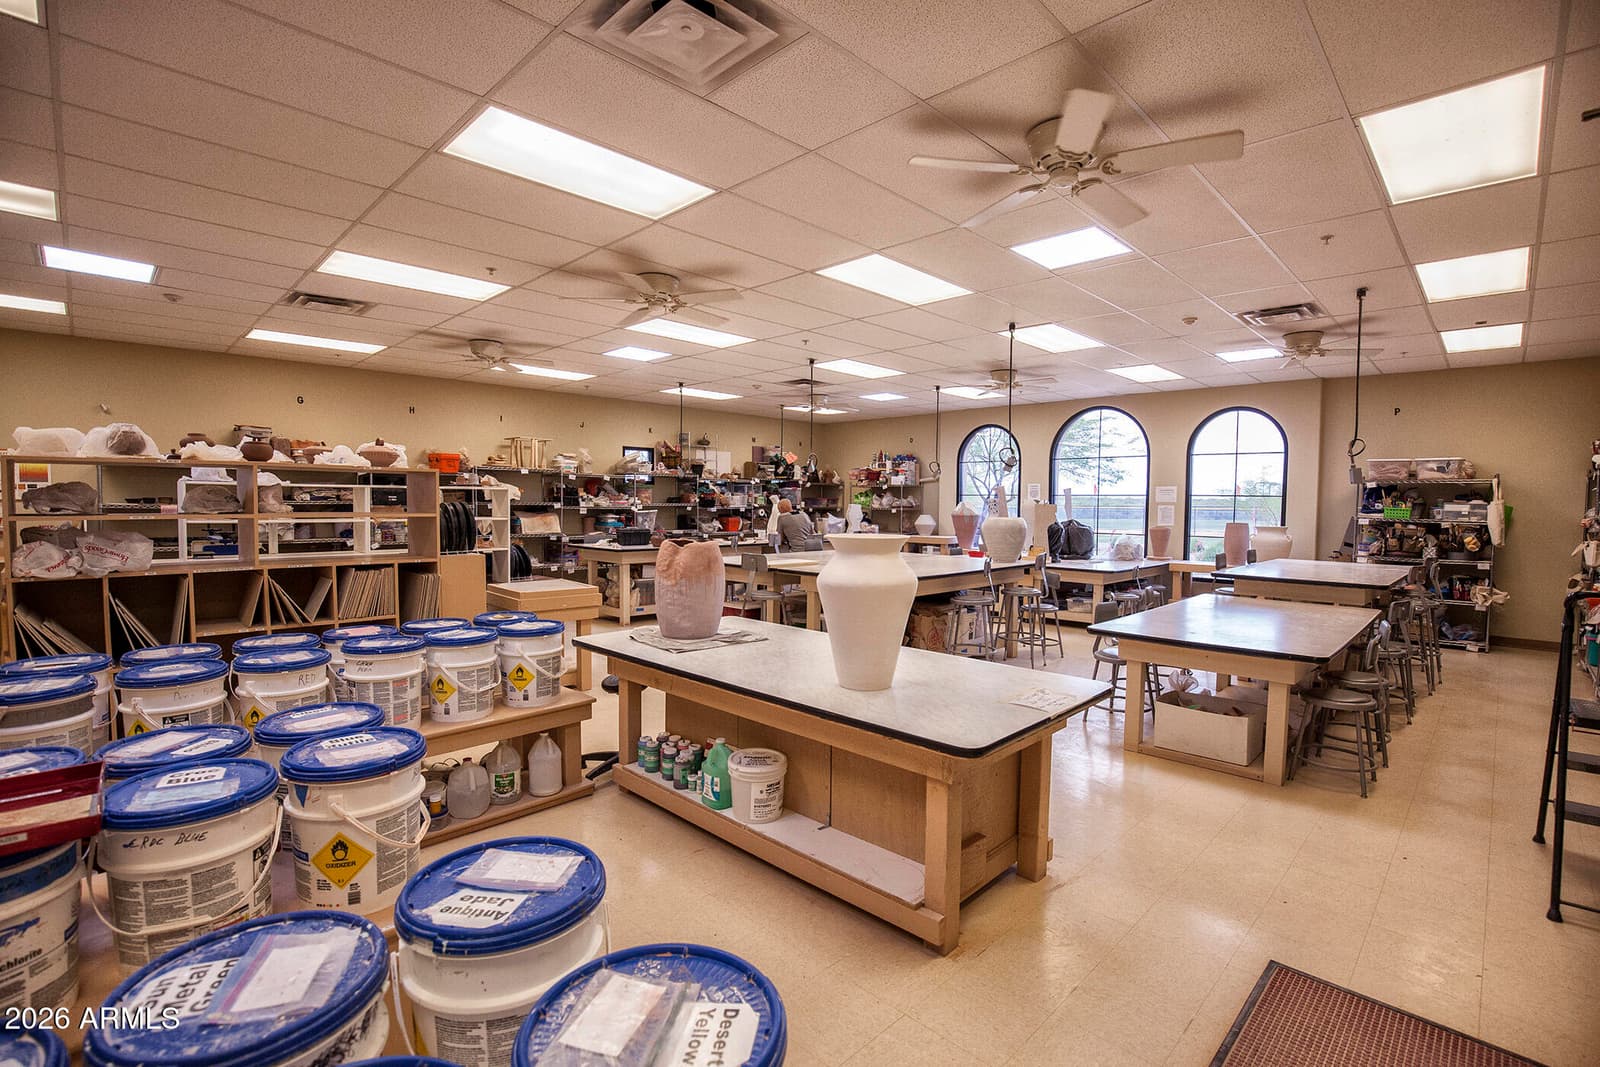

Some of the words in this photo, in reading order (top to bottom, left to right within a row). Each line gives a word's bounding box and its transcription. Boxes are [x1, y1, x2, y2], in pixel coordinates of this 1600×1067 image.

[296, 395, 304, 405] G
[409, 406, 415, 414] H
[1394, 407, 1401, 416] P
[166, 774, 217, 785] Blue
[174, 831, 208, 846] BLUE
[325, 860, 356, 869] OXIDIZER
[459, 894, 514, 904] Jade
[440, 905, 509, 921] Antique
[682, 1008, 717, 1066] Yellow
[707, 1008, 740, 1066] Desert
